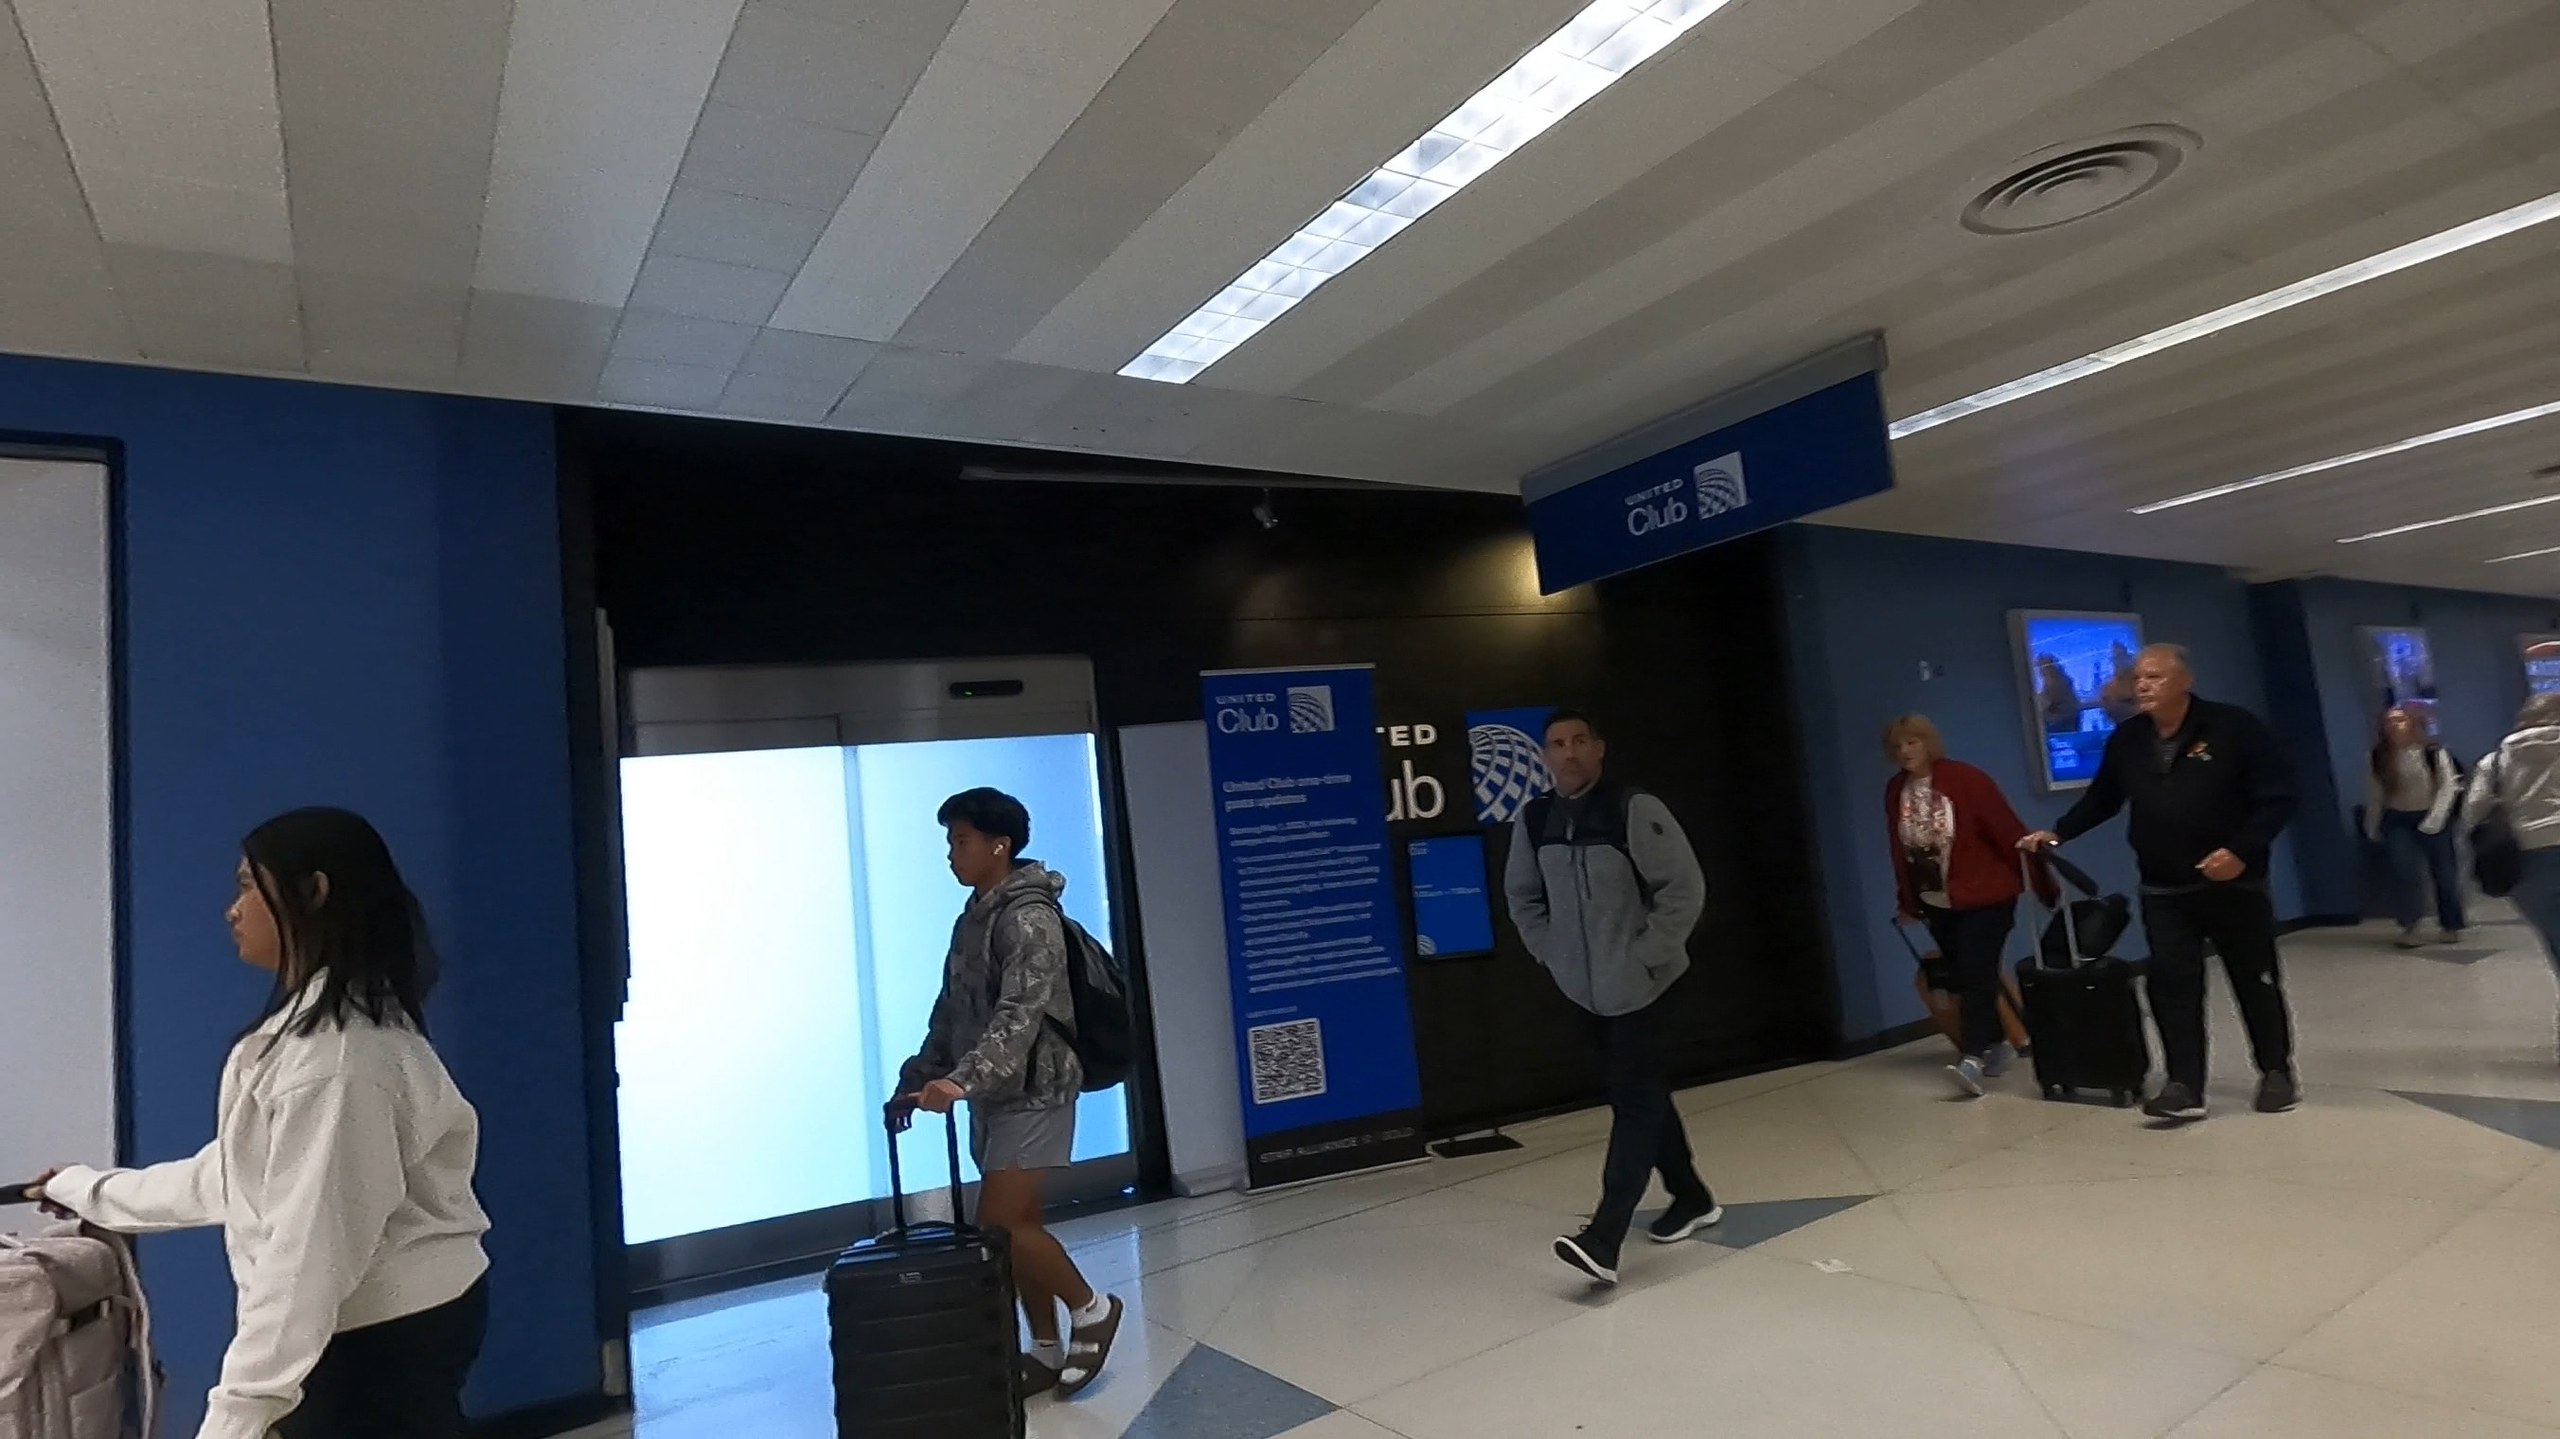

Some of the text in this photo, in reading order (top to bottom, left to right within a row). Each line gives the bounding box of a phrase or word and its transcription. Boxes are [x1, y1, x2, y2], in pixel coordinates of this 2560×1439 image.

[1624, 478, 1684, 506] UNITED
[1627, 496, 1688, 536] Club
[1215, 692, 1277, 705] UNITED
[1216, 707, 1279, 734] Club
